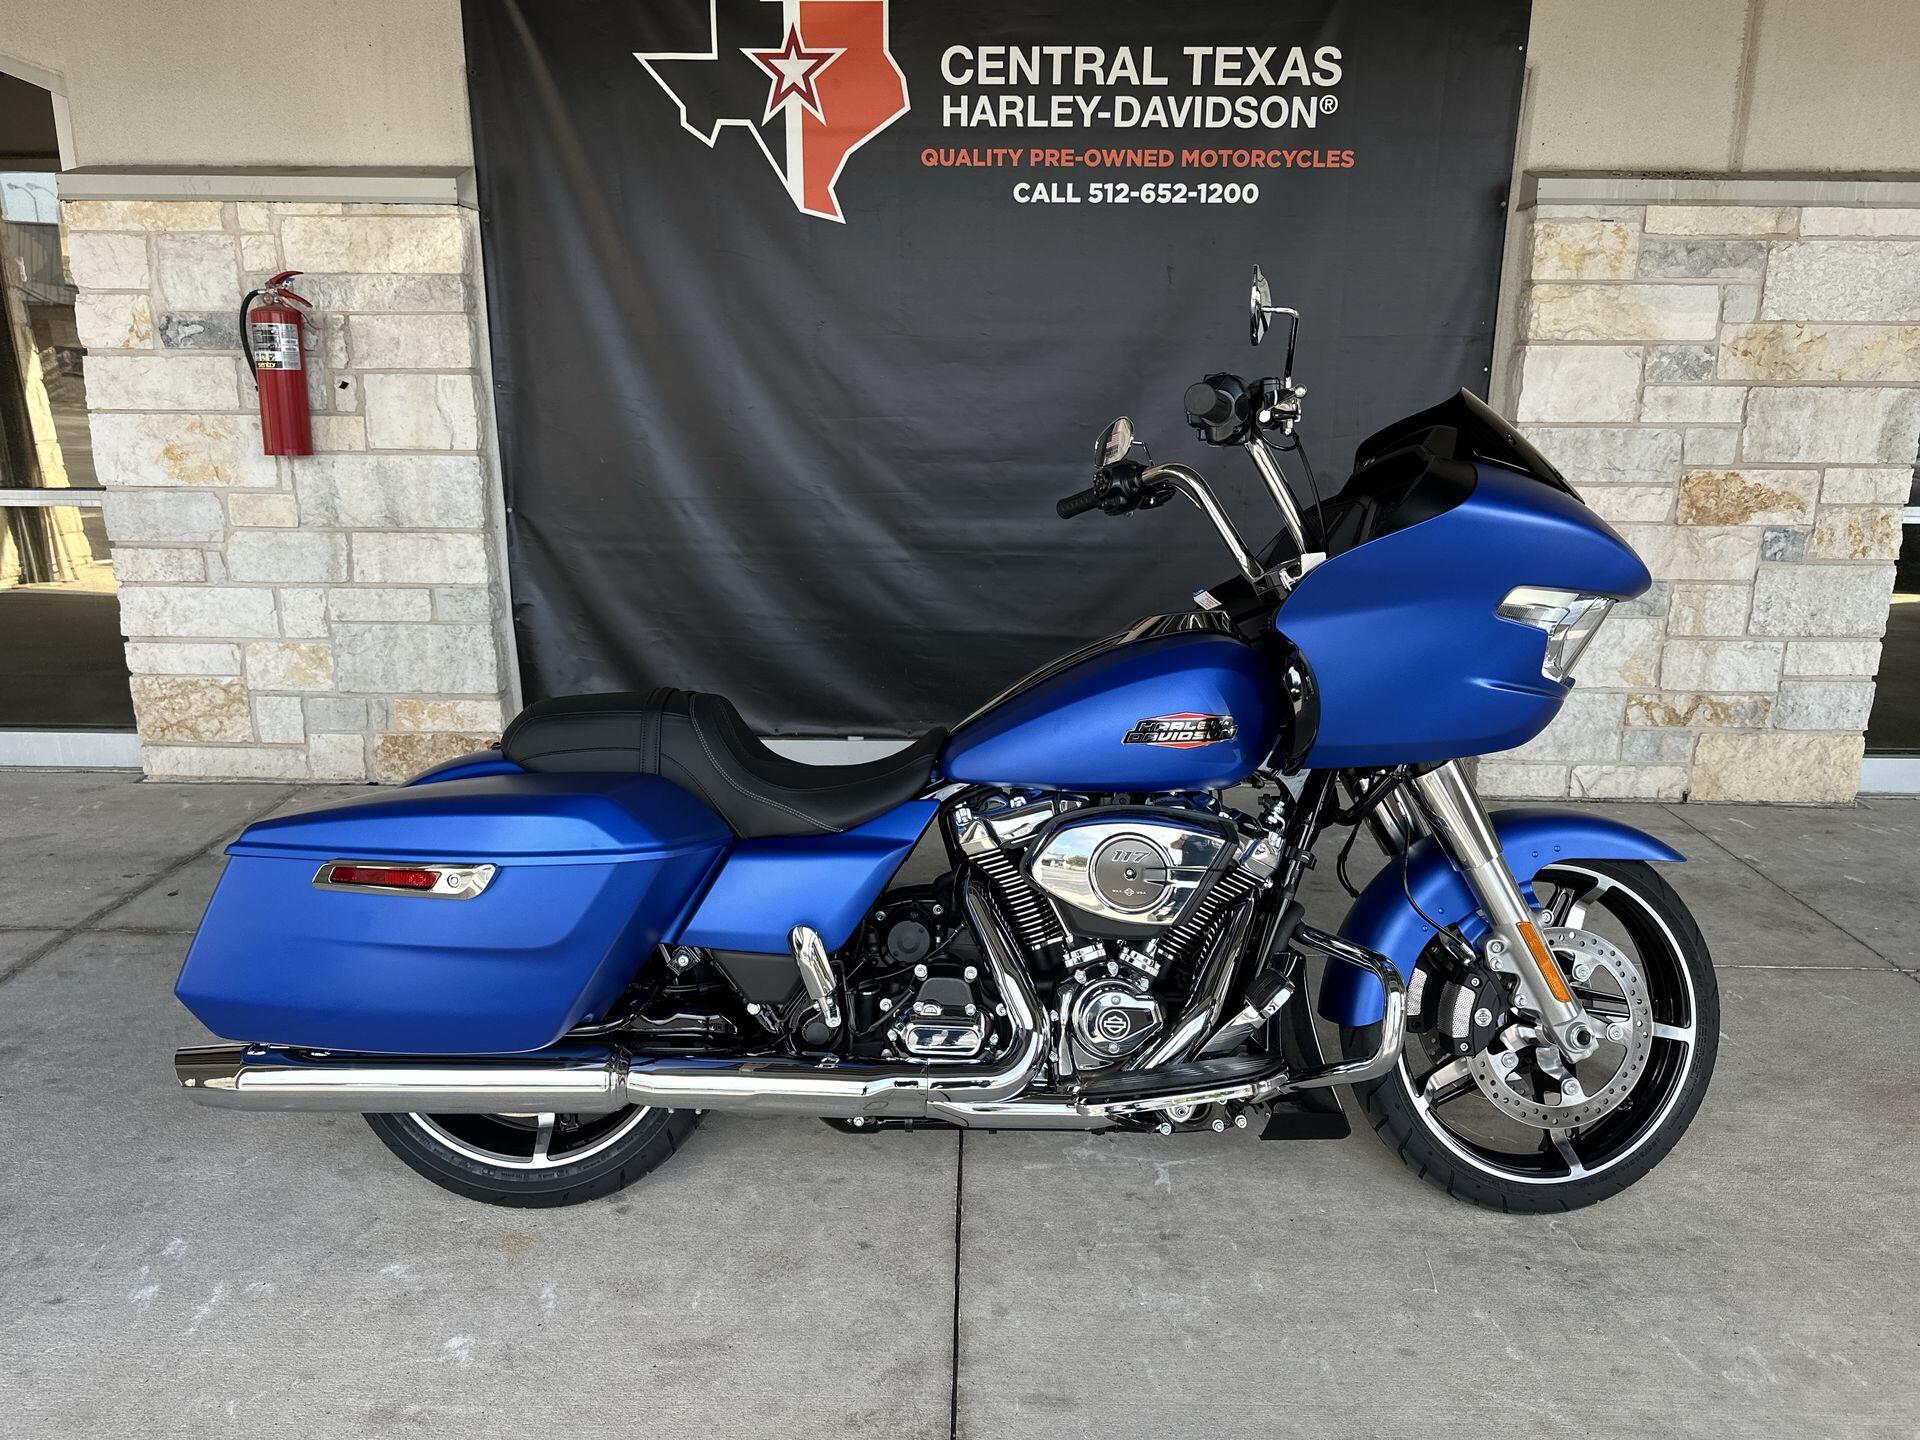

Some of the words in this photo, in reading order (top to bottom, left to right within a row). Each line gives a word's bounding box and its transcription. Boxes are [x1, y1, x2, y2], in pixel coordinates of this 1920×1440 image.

[940, 45, 1169, 86] CENTRAL
[1183, 46, 1343, 87] TEXAS
[920, 148, 1024, 168] QUALITY
[1029, 149, 1175, 168] PRE-OWNED
[1181, 149, 1355, 169] MOTORCYCLES
[1012, 182, 1082, 204] CALL
[1087, 182, 1260, 204] 512-652-1200
[1112, 849, 1151, 863] 117
